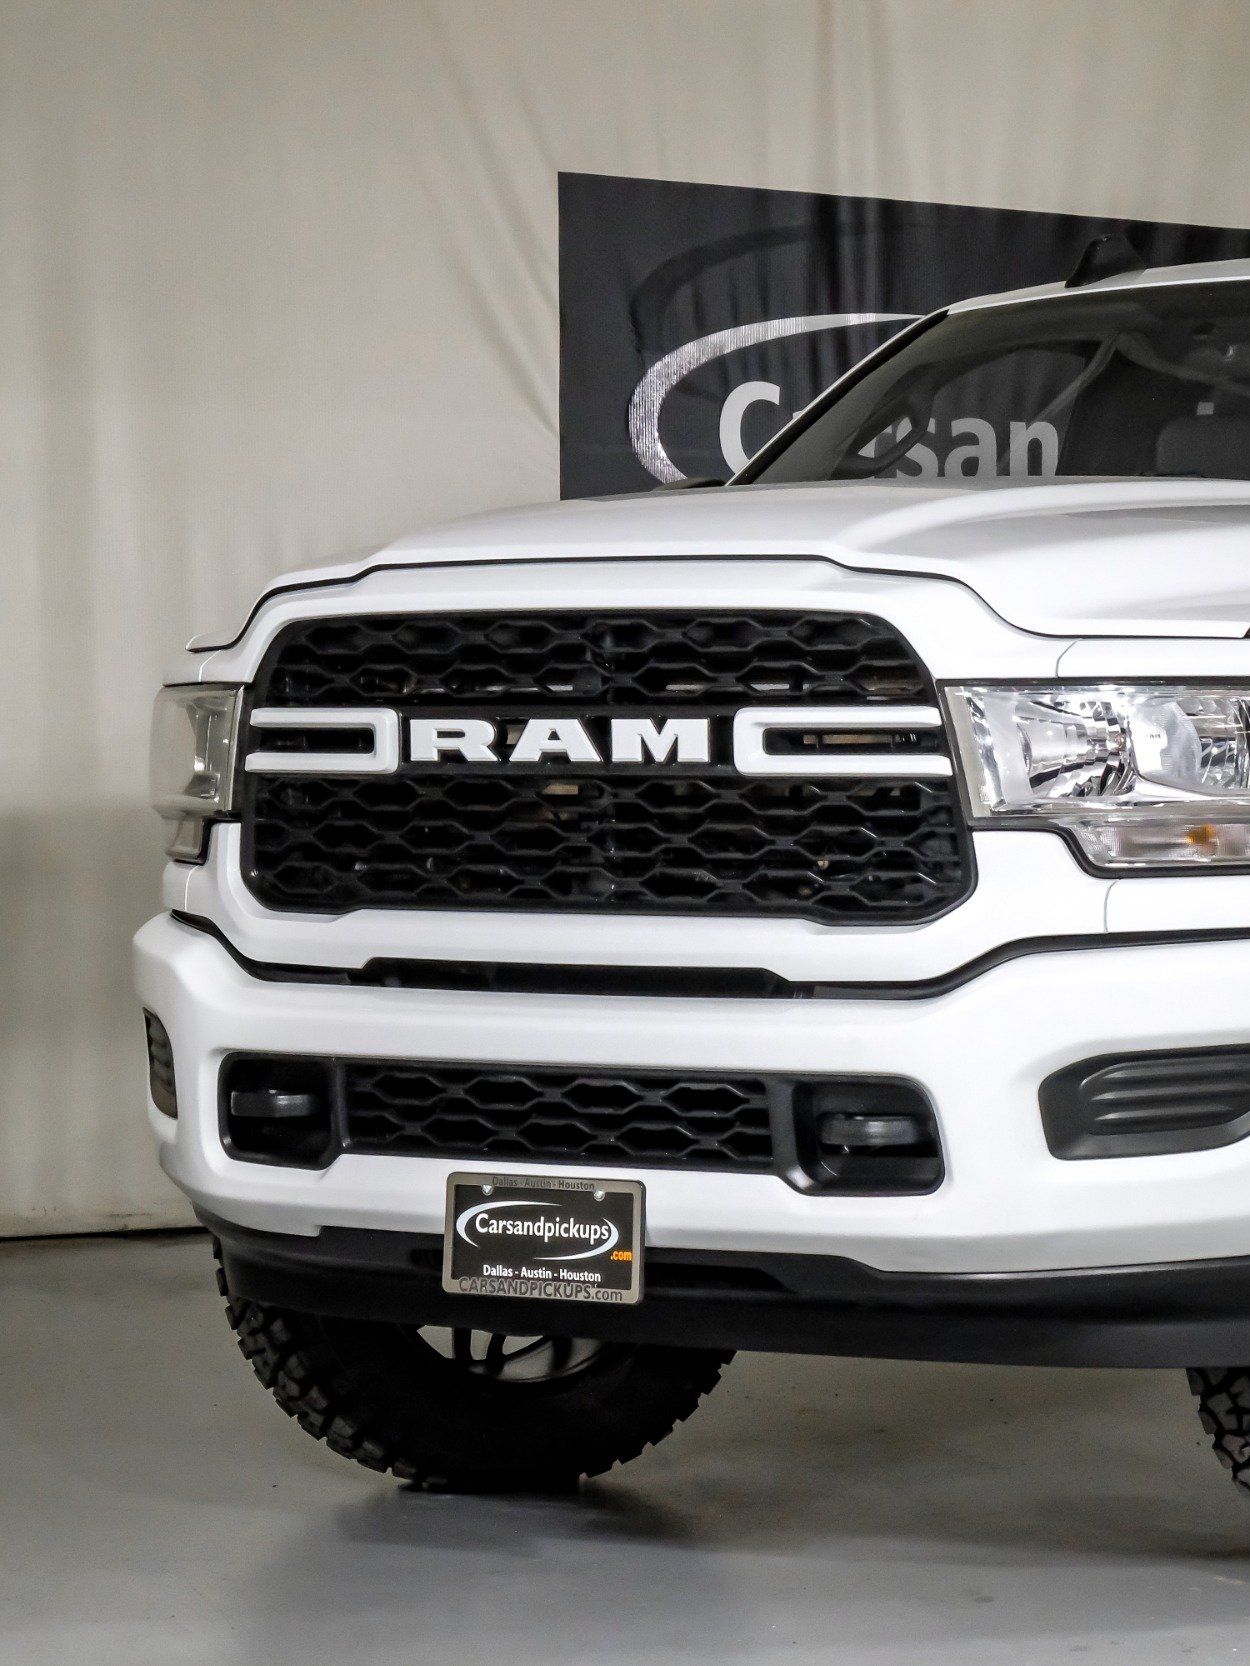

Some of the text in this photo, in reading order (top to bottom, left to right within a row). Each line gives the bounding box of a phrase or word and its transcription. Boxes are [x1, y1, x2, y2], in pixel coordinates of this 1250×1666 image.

[410, 717, 710, 763] RAM
[492, 1176, 518, 1187] Dallas
[524, 1178, 551, 1189] Austin
[558, 1180, 595, 1190] Houston
[475, 1213, 610, 1245] Carsandpickups
[610, 1250, 632, 1261] .com
[483, 1264, 513, 1277] Dallas
[520, 1267, 552, 1279] Austin
[559, 1268, 601, 1282] Houston
[458, 1277, 623, 1302] CARSANDPICKUPS.com
